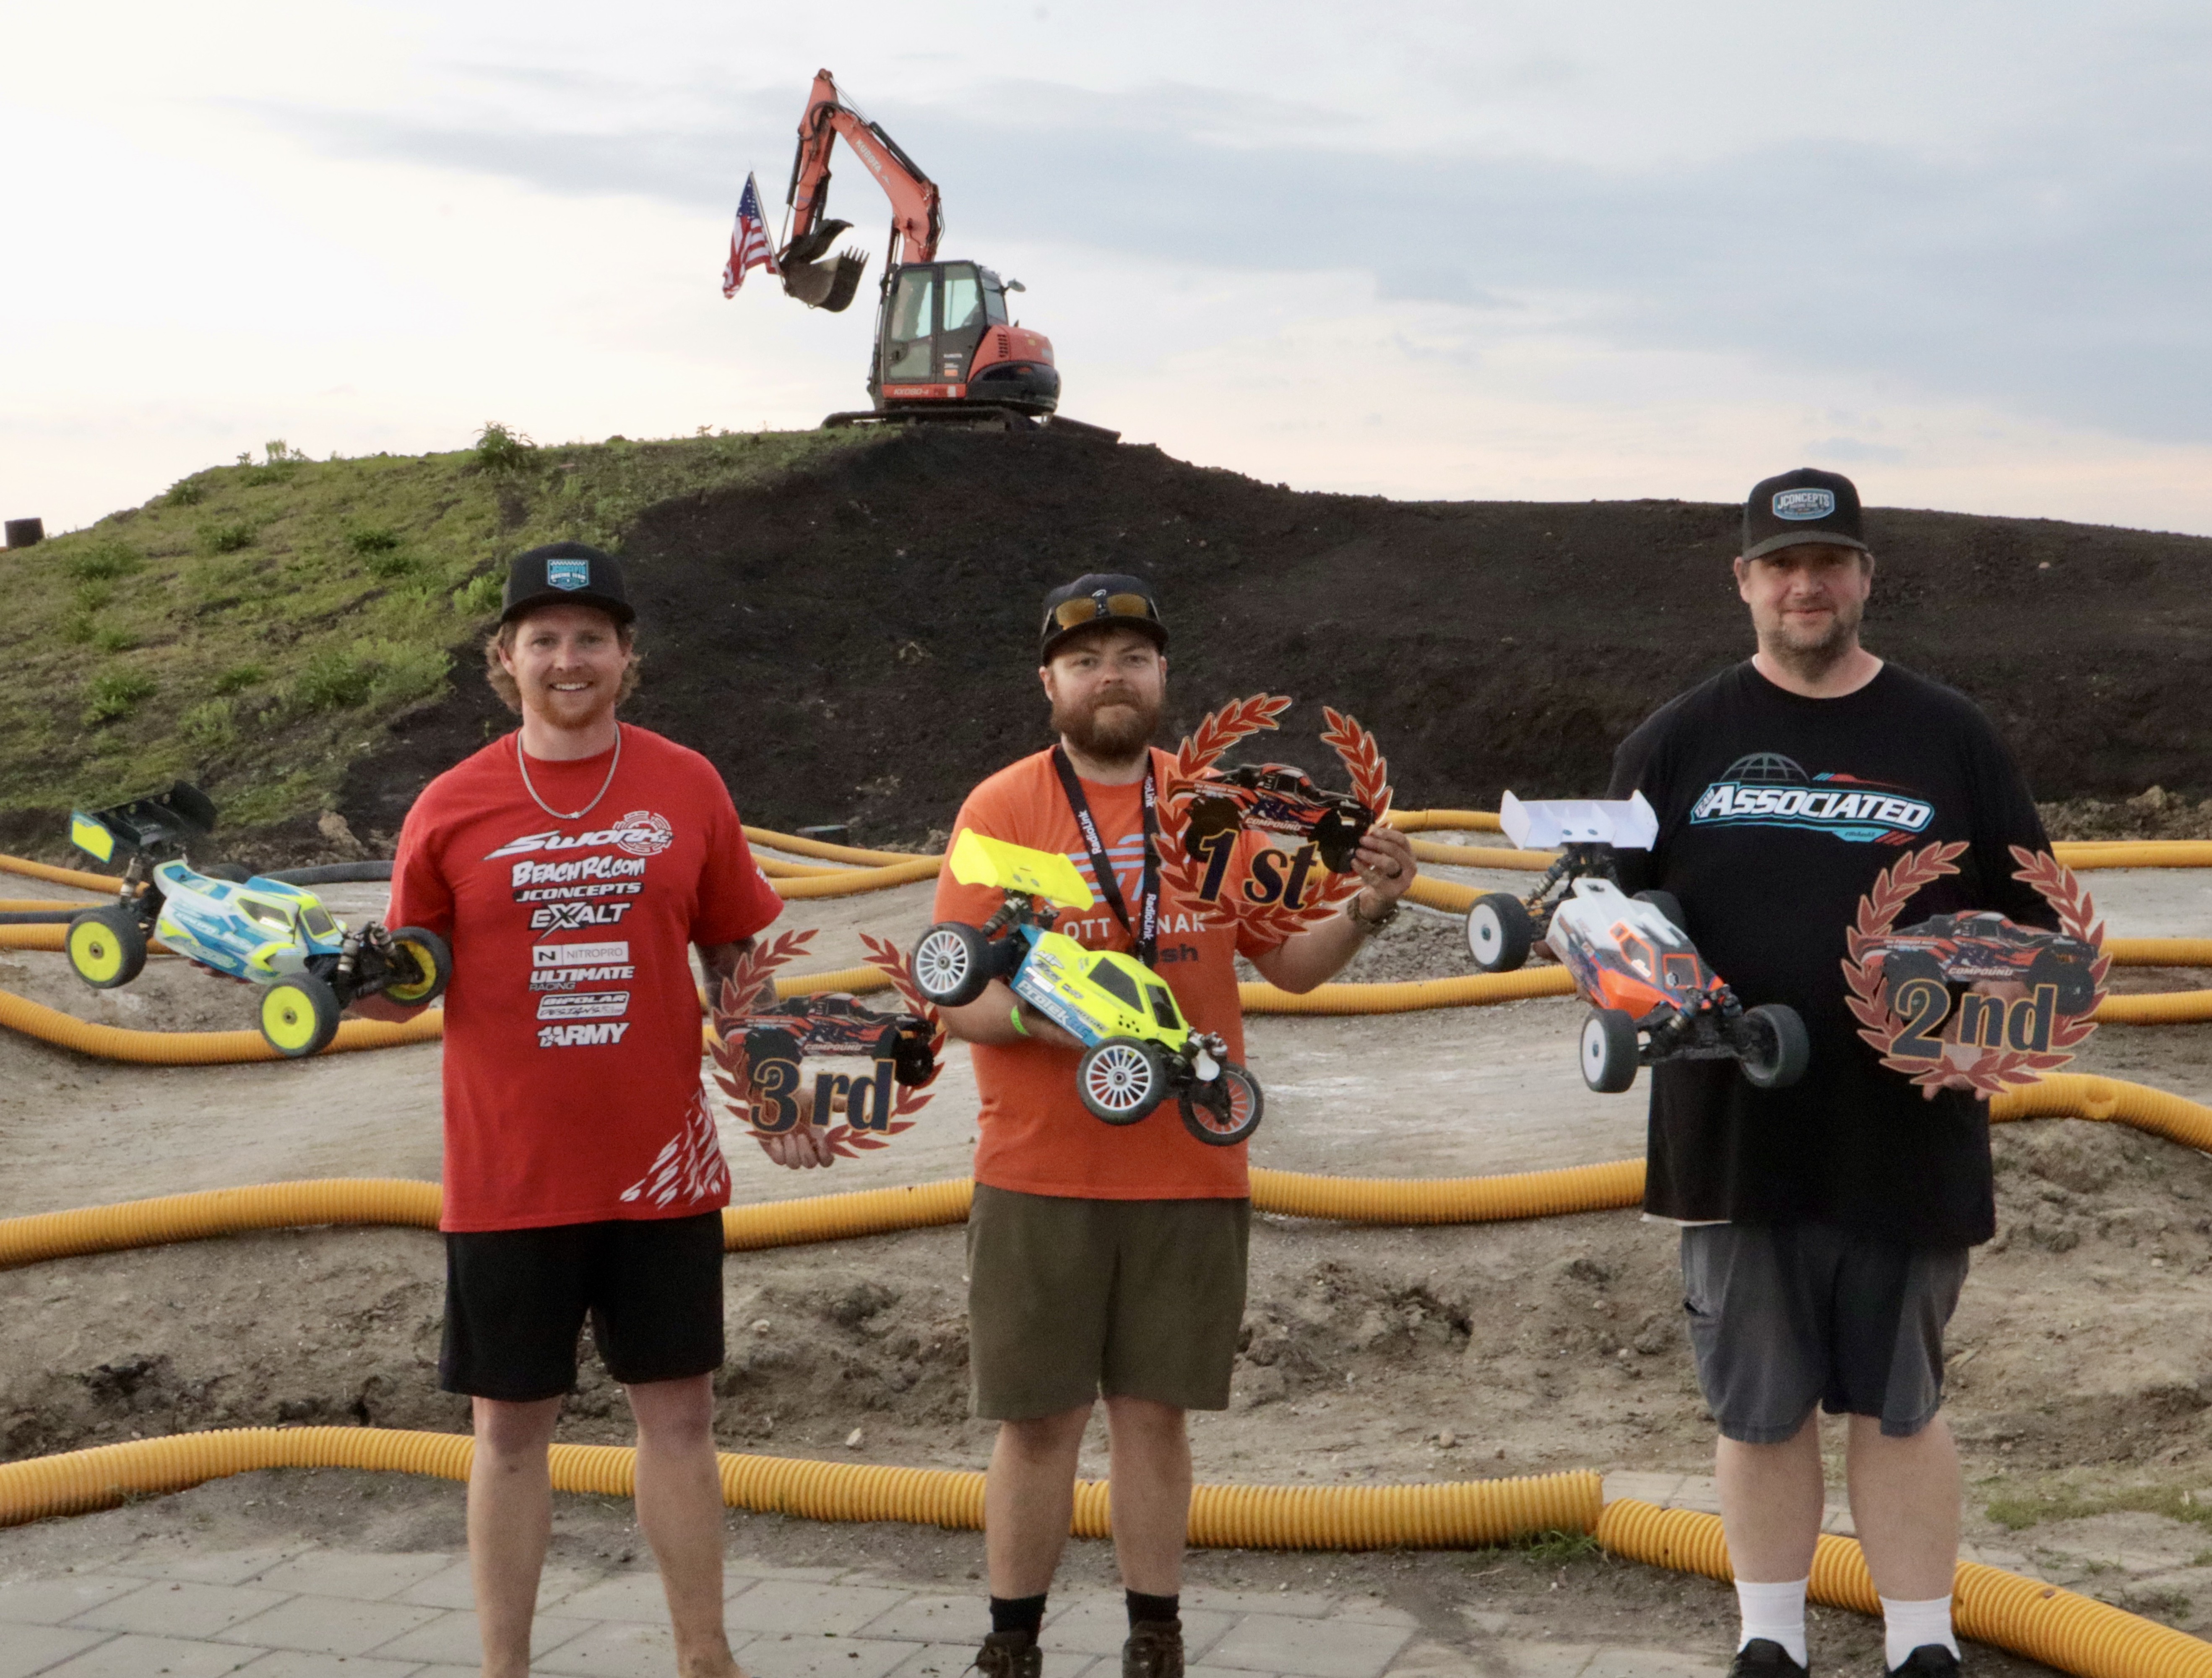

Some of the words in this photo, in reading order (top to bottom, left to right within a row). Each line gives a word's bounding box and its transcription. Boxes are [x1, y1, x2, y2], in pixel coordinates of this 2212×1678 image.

[856, 139, 882, 173] KUBOTA
[1777, 492, 1829, 509] JCONCEPTS
[1699, 785, 1930, 828] ASSOCIATED
[1245, 818, 1302, 831] COMPOUND
[516, 882, 643, 902] JCONCEPTS
[529, 902, 631, 938] EXALT
[1063, 917, 1111, 941] OTT
[538, 951, 556, 961] N
[567, 947, 624, 959] NITROPRO
[530, 966, 635, 984] ULTIMATE
[1948, 966, 2014, 977] COMPOUND
[529, 982, 576, 992] RACING
[543, 994, 627, 1006] BIPOLAR
